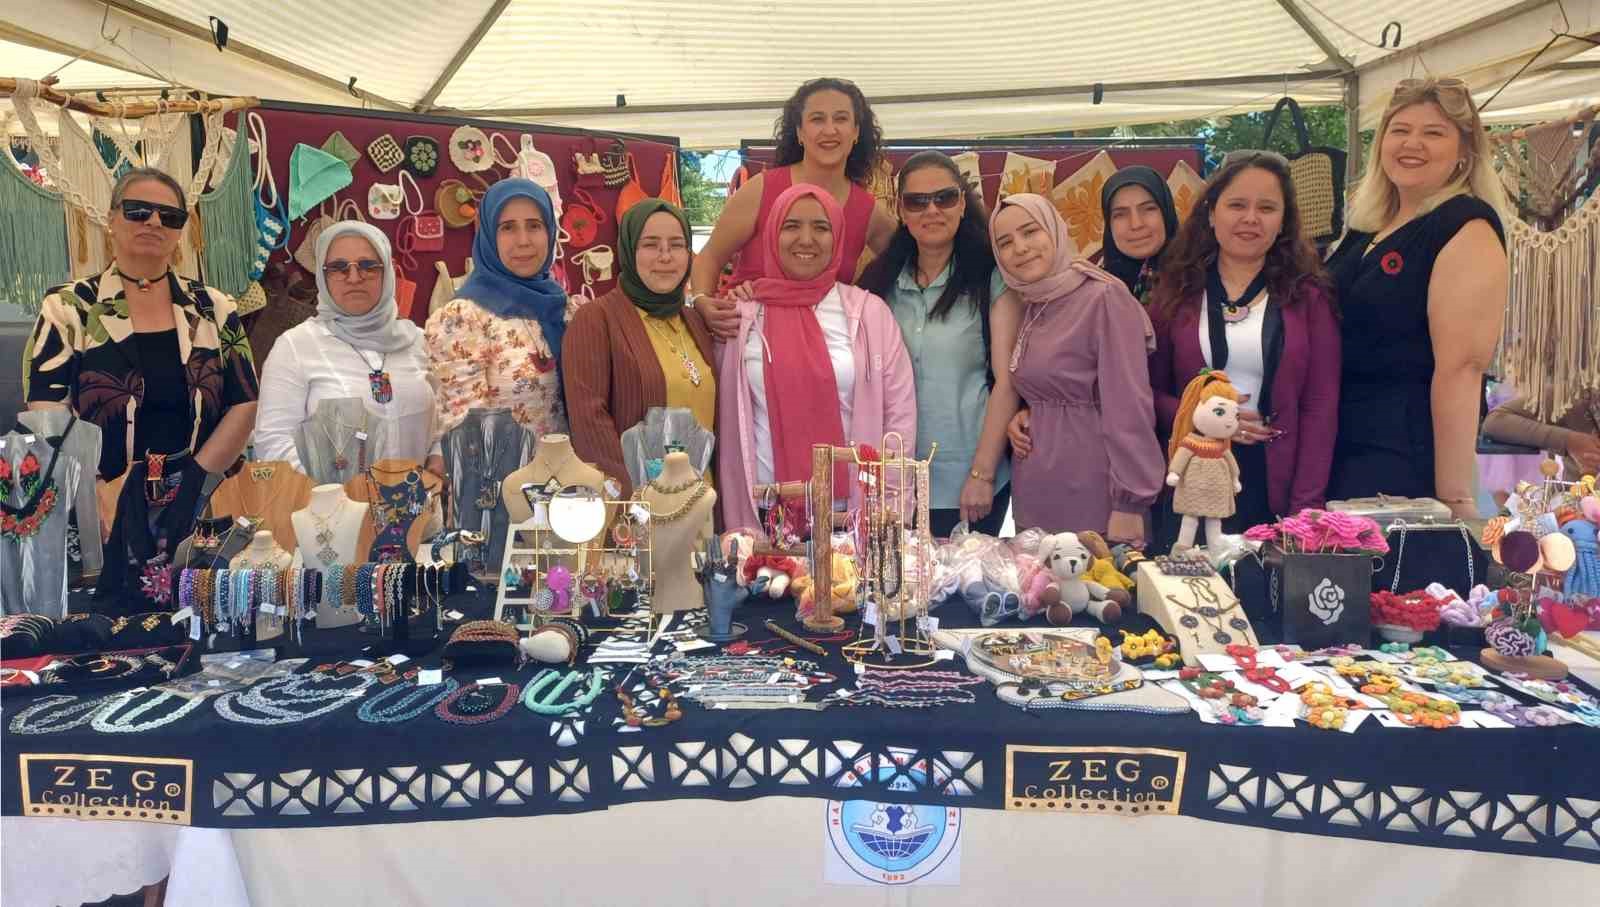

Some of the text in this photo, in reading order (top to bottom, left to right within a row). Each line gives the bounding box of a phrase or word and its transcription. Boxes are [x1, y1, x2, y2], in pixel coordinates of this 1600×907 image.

[54, 765, 158, 791] ZEG
[1048, 758, 1141, 782] ZEG
[42, 790, 170, 810] Collection
[1024, 785, 1156, 802] Collection
